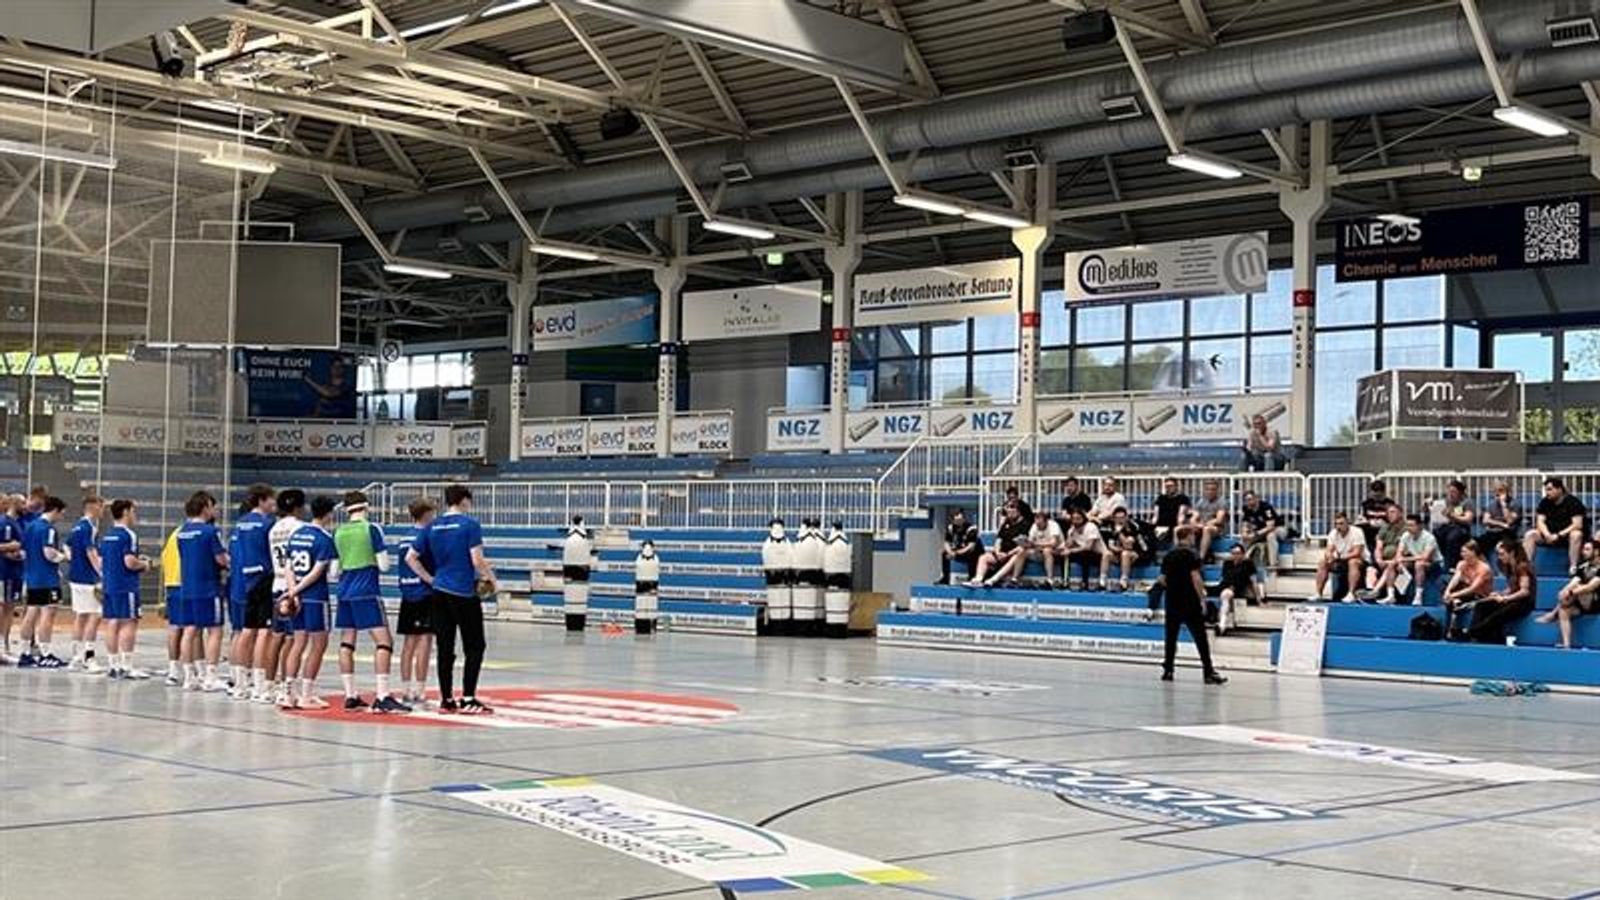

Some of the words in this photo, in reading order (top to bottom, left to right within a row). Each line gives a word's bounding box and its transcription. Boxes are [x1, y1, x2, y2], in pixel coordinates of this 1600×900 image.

[1344, 222, 1422, 248] INEOS
[1343, 261, 1397, 277] Chemie
[1420, 254, 1498, 271] Menschen
[546, 310, 576, 333] evd
[283, 358, 312, 368] EUCH
[972, 411, 1014, 430] NGZ
[1080, 410, 1125, 426] NGZ
[1183, 403, 1233, 424] NGZ
[778, 419, 821, 437] NGZ
[884, 415, 922, 433] NGZ
[326, 429, 366, 448] evd
[408, 429, 435, 444] evd
[600, 426, 625, 447] evd
[698, 440, 729, 449] BLOCK
[264, 444, 303, 453] BLOCK
[396, 448, 433, 456] BLOCK
[557, 444, 583, 453] BLOCK
[628, 441, 656, 451] BLOCK
[290, 549, 311, 572] 29
[922, 748, 1315, 820] YNCORIS
